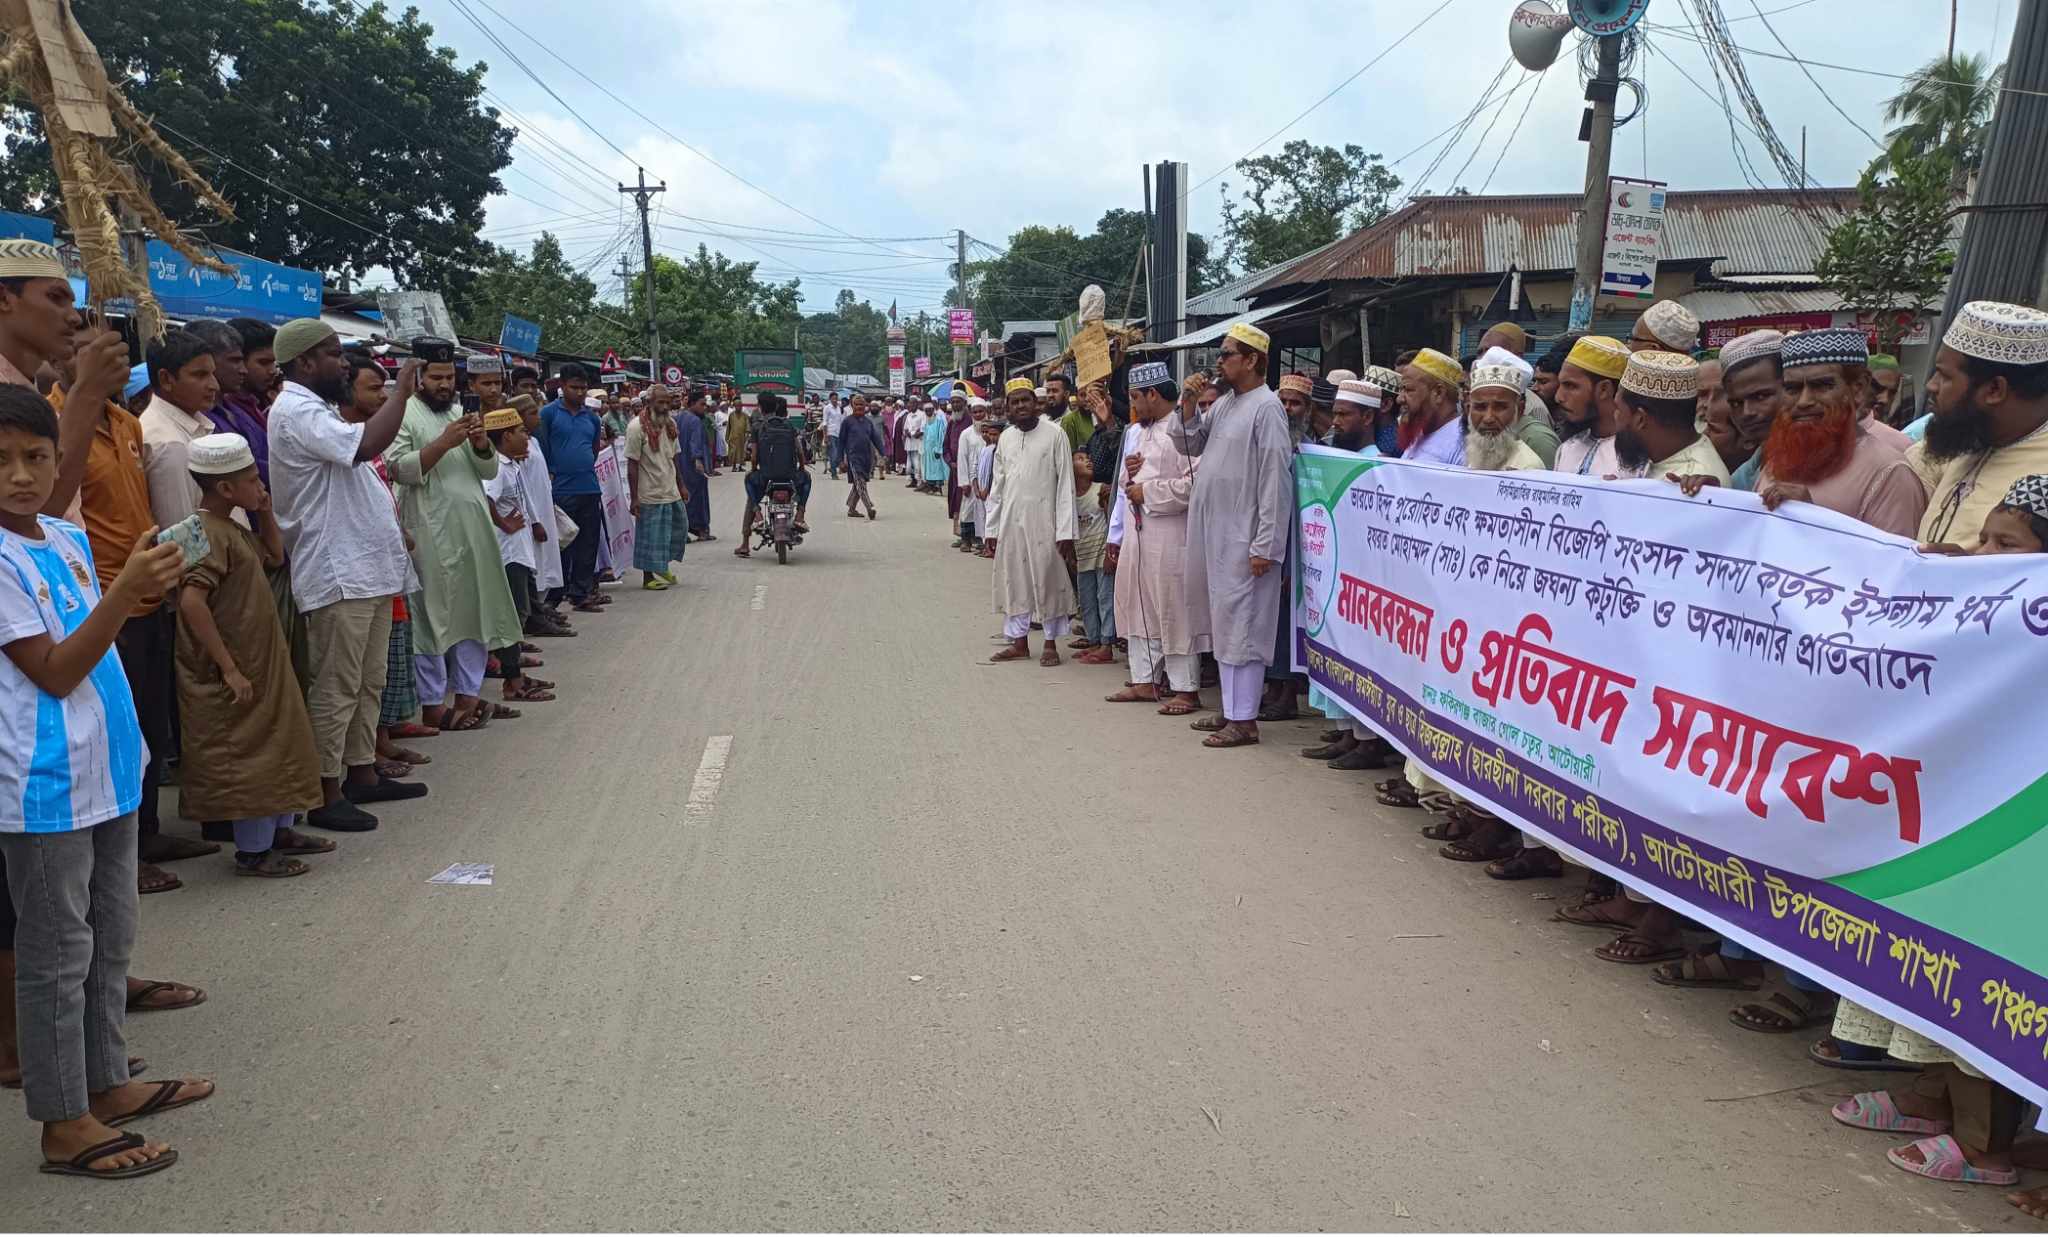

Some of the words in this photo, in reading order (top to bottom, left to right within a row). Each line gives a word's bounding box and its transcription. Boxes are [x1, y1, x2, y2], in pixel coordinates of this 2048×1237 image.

[1350, 486, 1375, 512] ভারতে
[1375, 484, 1395, 521] হিন্দু
[1395, 488, 1443, 531] পুরোহিত
[1443, 505, 1468, 534] এবং
[1473, 505, 1545, 547] ক্ষমতাসীন
[1546, 513, 1611, 562] বিজেপি
[1614, 533, 1689, 580] সংসদ
[1695, 549, 1757, 596] সদস্য
[1841, 577, 1954, 630] ইসলাম
[1954, 577, 2029, 636] ধর্ম
[1366, 525, 1390, 555] হযরত
[1390, 530, 1432, 570] মোহাম্মদ
[1431, 543, 1466, 579] (সাঃ)
[1468, 553, 1489, 585] কে
[1493, 549, 1529, 593] নিয়ে
[1532, 566, 1583, 606] জঘন্য
[1653, 598, 1675, 628] ও
[1686, 602, 1793, 666] অবমাননার
[1795, 630, 1937, 696] প্রতিবাদে
[1336, 571, 1434, 663] মানববন্ধন
[1440, 617, 1469, 675] ও
[1471, 612, 1637, 745] প্রতিবাদ
[1642, 685, 1923, 845] সমাবেশ
[1471, 706, 1497, 737] বাজার
[1498, 720, 1520, 745] গোল
[1397, 704, 1404, 726] ও
[1418, 708, 1465, 769] হিজবুল্লাহ
[1522, 768, 1568, 826] দরবার
[1642, 830, 1757, 912] আটোয়ারী
[1764, 868, 1882, 968] উপজেলা
[1889, 930, 1961, 1020] শাখা,
